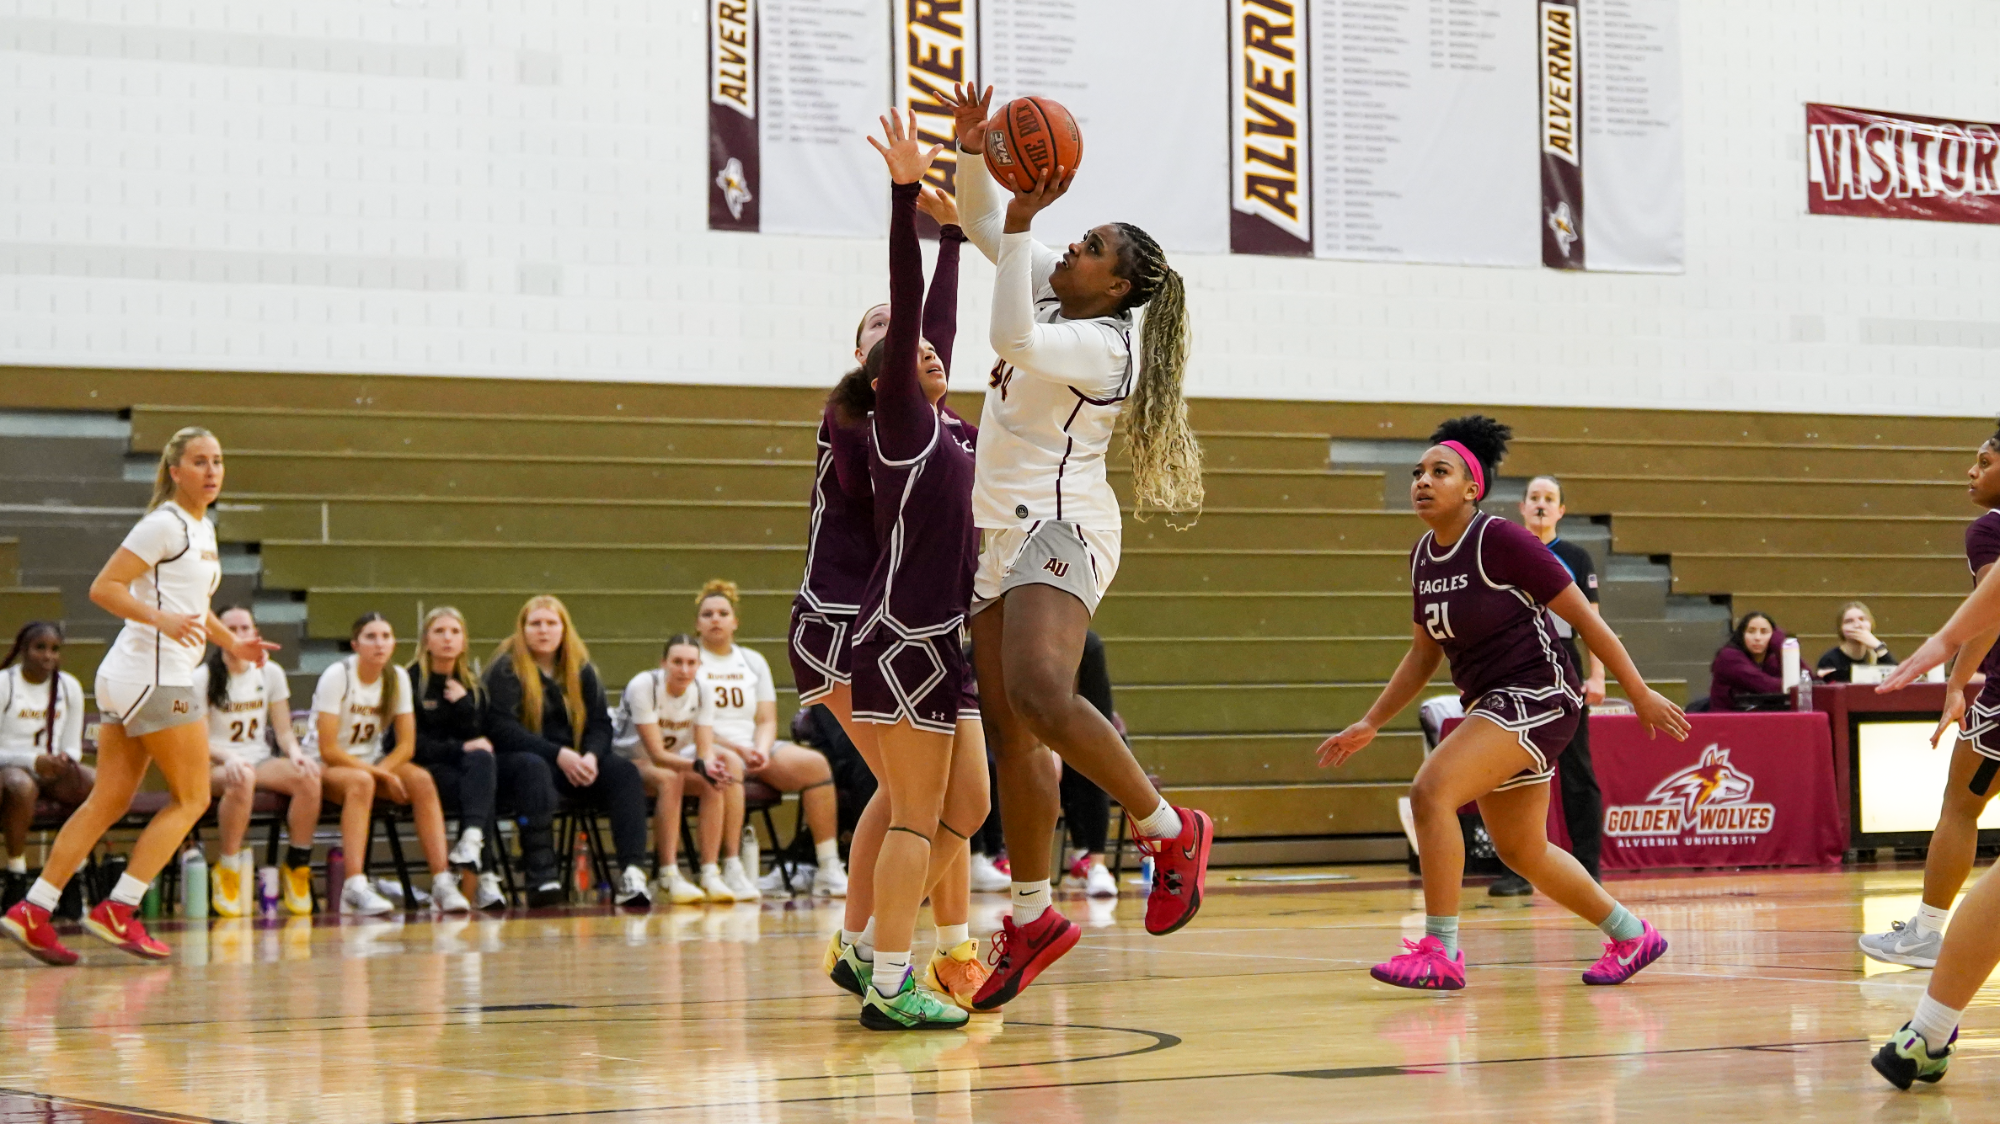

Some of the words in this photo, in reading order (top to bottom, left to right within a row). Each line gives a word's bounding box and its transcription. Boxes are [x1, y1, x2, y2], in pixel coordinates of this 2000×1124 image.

[719, 0, 748, 107] ALVER
[1547, 10, 1574, 156] ALVERNIA
[994, 132, 1012, 164] MAC
[1023, 138, 1050, 172] THE
[1042, 557, 1071, 578] AU
[1419, 574, 1469, 595] EAGLES
[1424, 601, 1456, 640] 21
[172, 699, 190, 714] AU
[714, 686, 744, 709] 30
[1607, 808, 1682, 833] GOLDEN
[1700, 806, 1772, 831] WOLVES
[1617, 836, 1679, 849] ALVERNIA
[1684, 834, 1757, 847] UNIVERSITY
